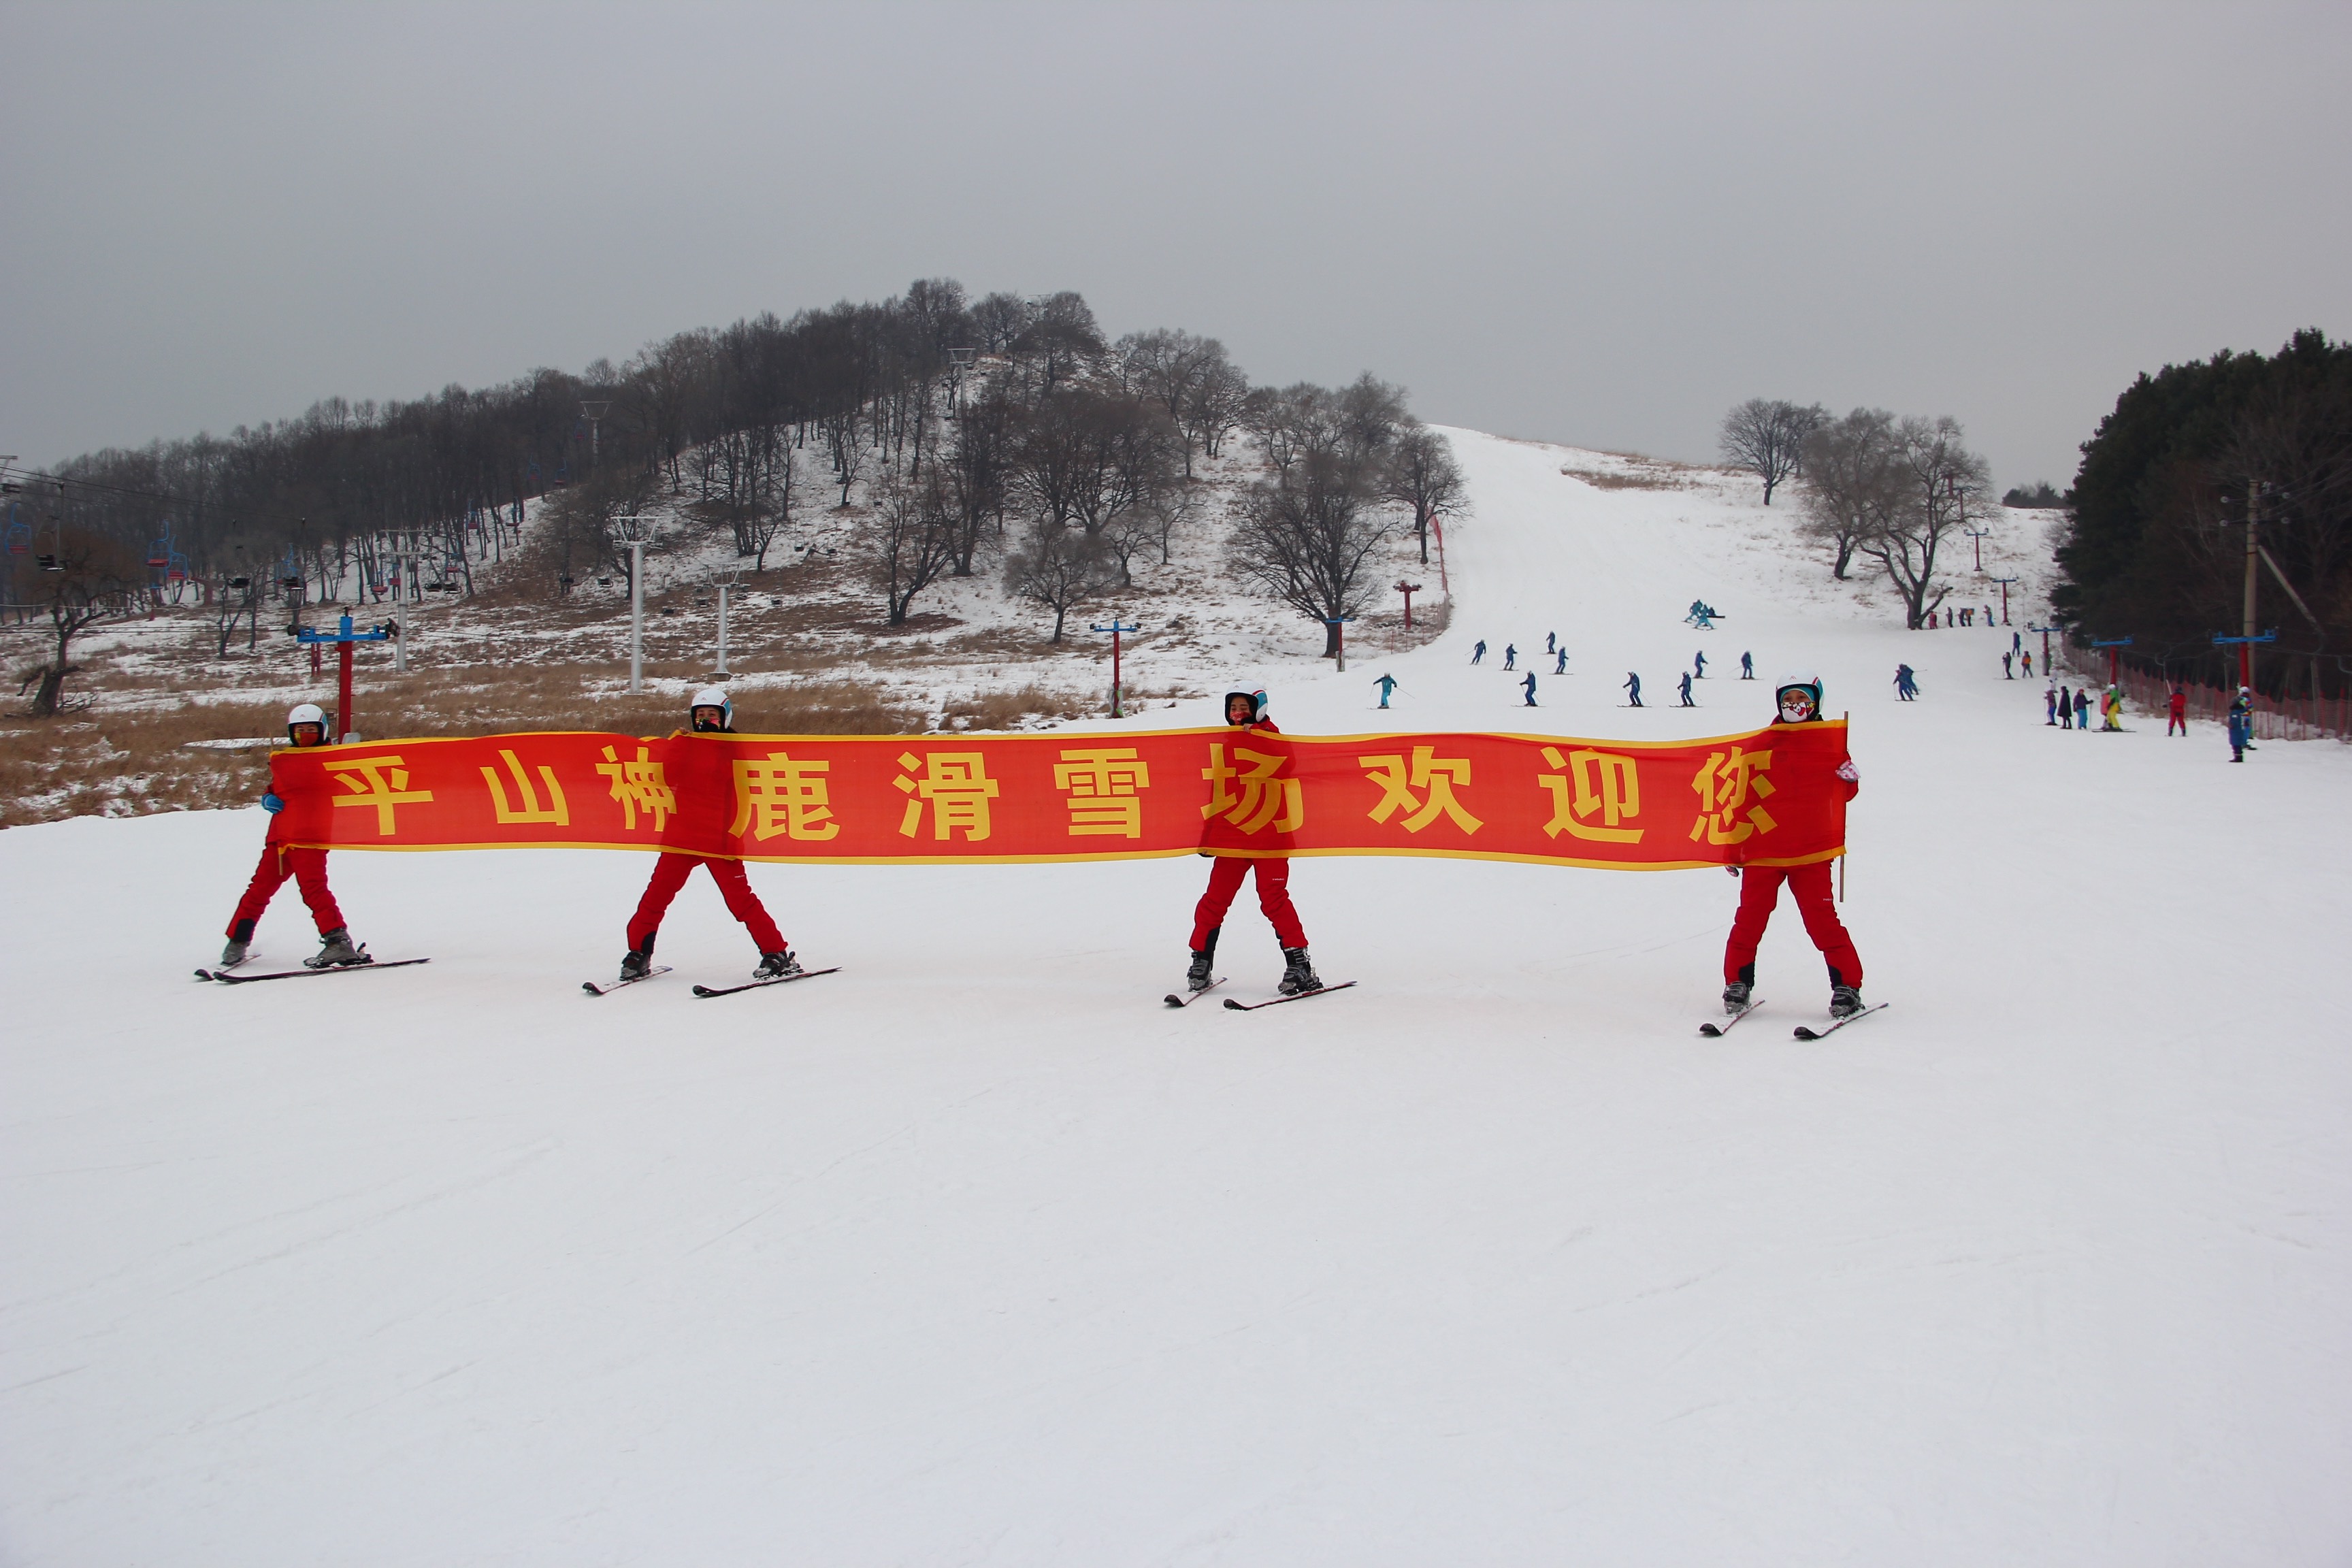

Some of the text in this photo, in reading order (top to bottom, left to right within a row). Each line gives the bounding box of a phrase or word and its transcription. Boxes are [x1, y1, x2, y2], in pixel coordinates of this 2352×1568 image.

[323, 743, 1778, 845] 平山神鹿滑雪场欢迎您
